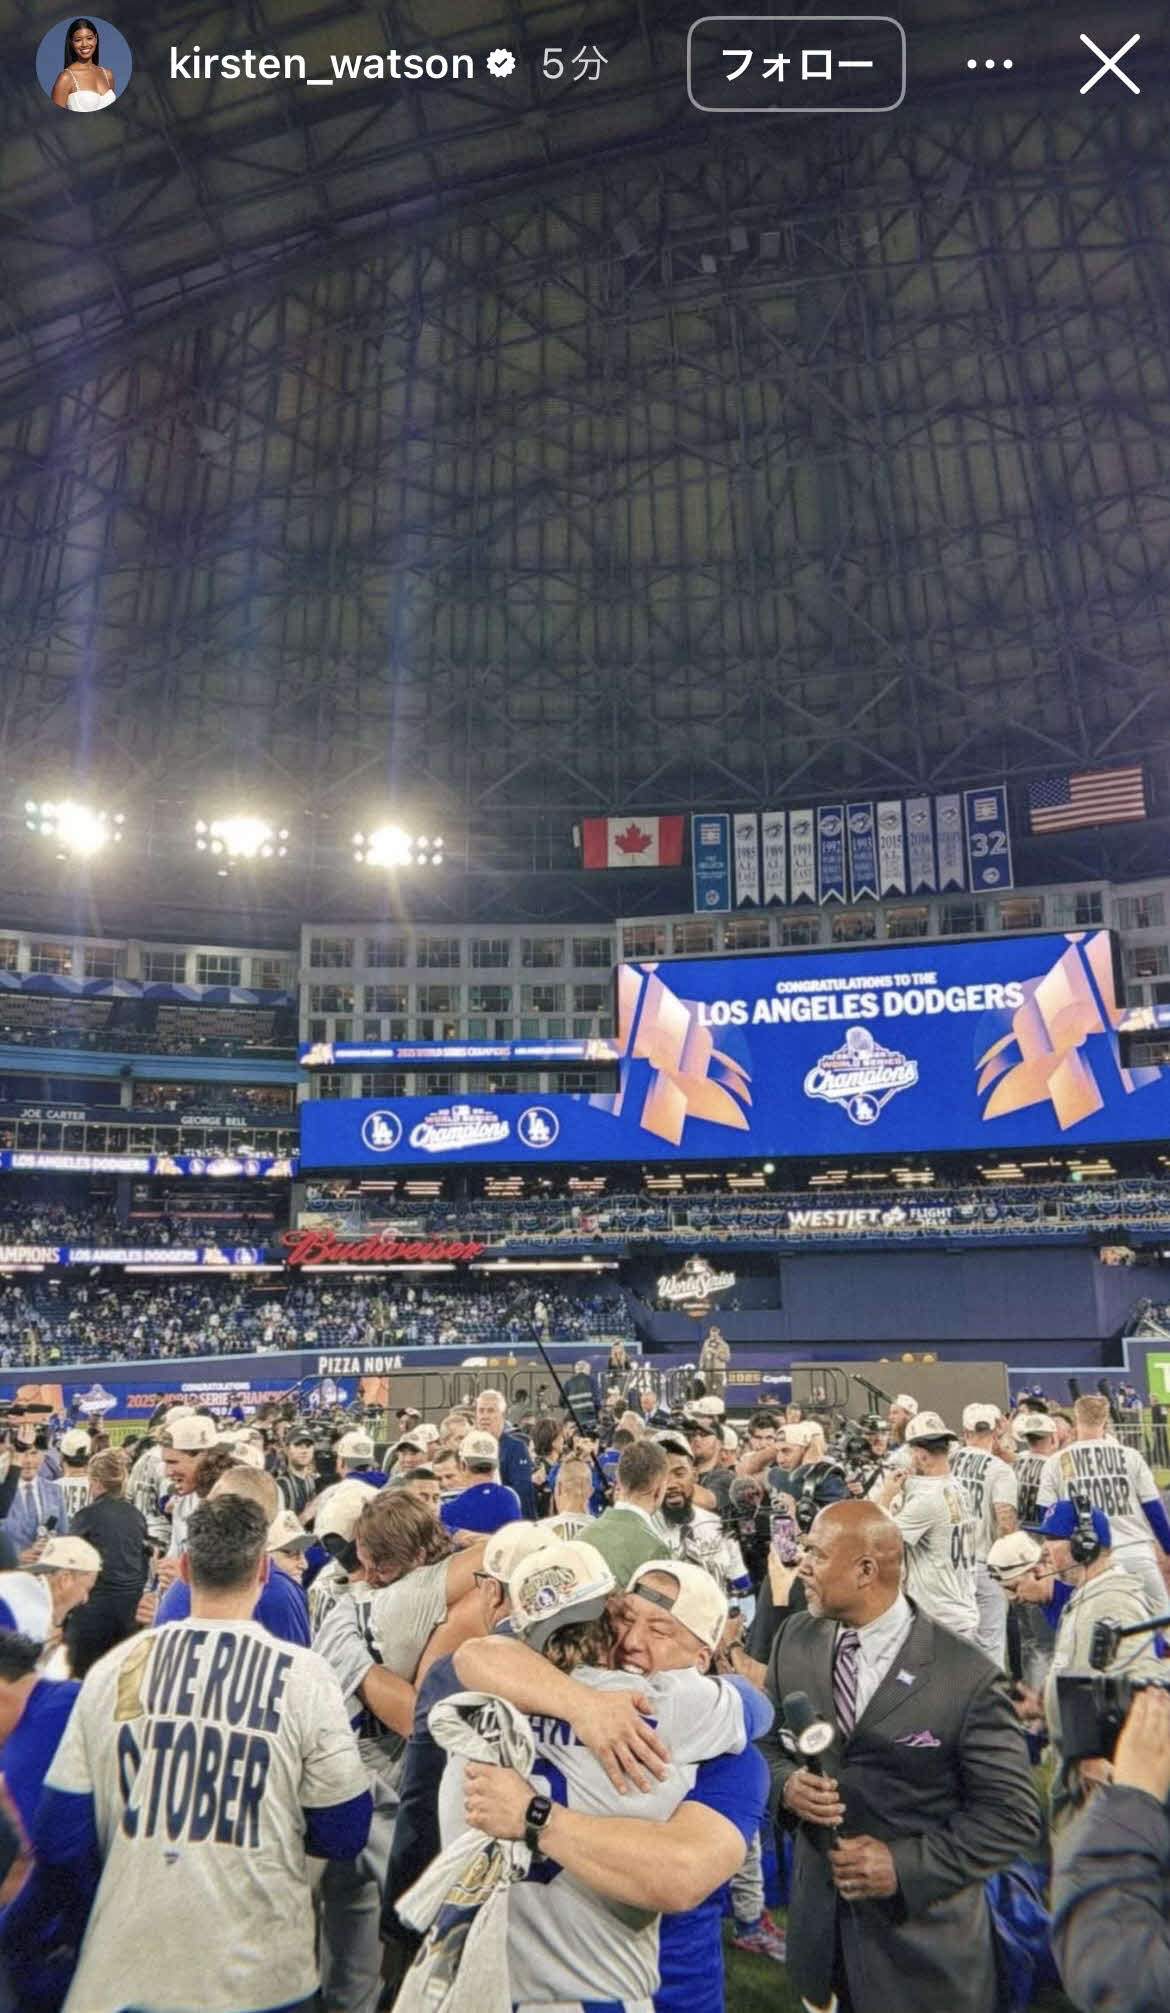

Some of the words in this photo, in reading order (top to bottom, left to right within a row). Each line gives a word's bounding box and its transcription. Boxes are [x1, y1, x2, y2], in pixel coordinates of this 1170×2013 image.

[970, 831, 1008, 857] 32
[776, 974, 893, 994] CONGRATULATIONS
[894, 972, 911, 987] TO
[911, 971, 938, 986] THE
[697, 1000, 749, 1027] LOS
[752, 992, 880, 1025] ANGELES
[883, 982, 1025, 1017] DODGERS
[804, 1060, 919, 1100] Champions
[20, 1108, 41, 1119] JOE
[46, 1109, 86, 1121] CARTER
[181, 1115, 222, 1126] GEORGE
[225, 1116, 248, 1127] BELL
[409, 1120, 510, 1152] Champions
[787, 1208, 881, 1228] WESTJET
[910, 1207, 952, 1219] FLIGHT
[281, 1227, 486, 1266] Budweiser
[657, 1273, 698, 1300] World
[318, 1356, 360, 1375] PIZZA
[363, 1354, 402, 1373] NOVA
[1071, 1447, 1095, 1477] WE
[1094, 1446, 1128, 1475] RULE
[149, 1629, 209, 1717] WE
[202, 1631, 294, 1734] RULE
[117, 1719, 271, 1849] OTOBER
